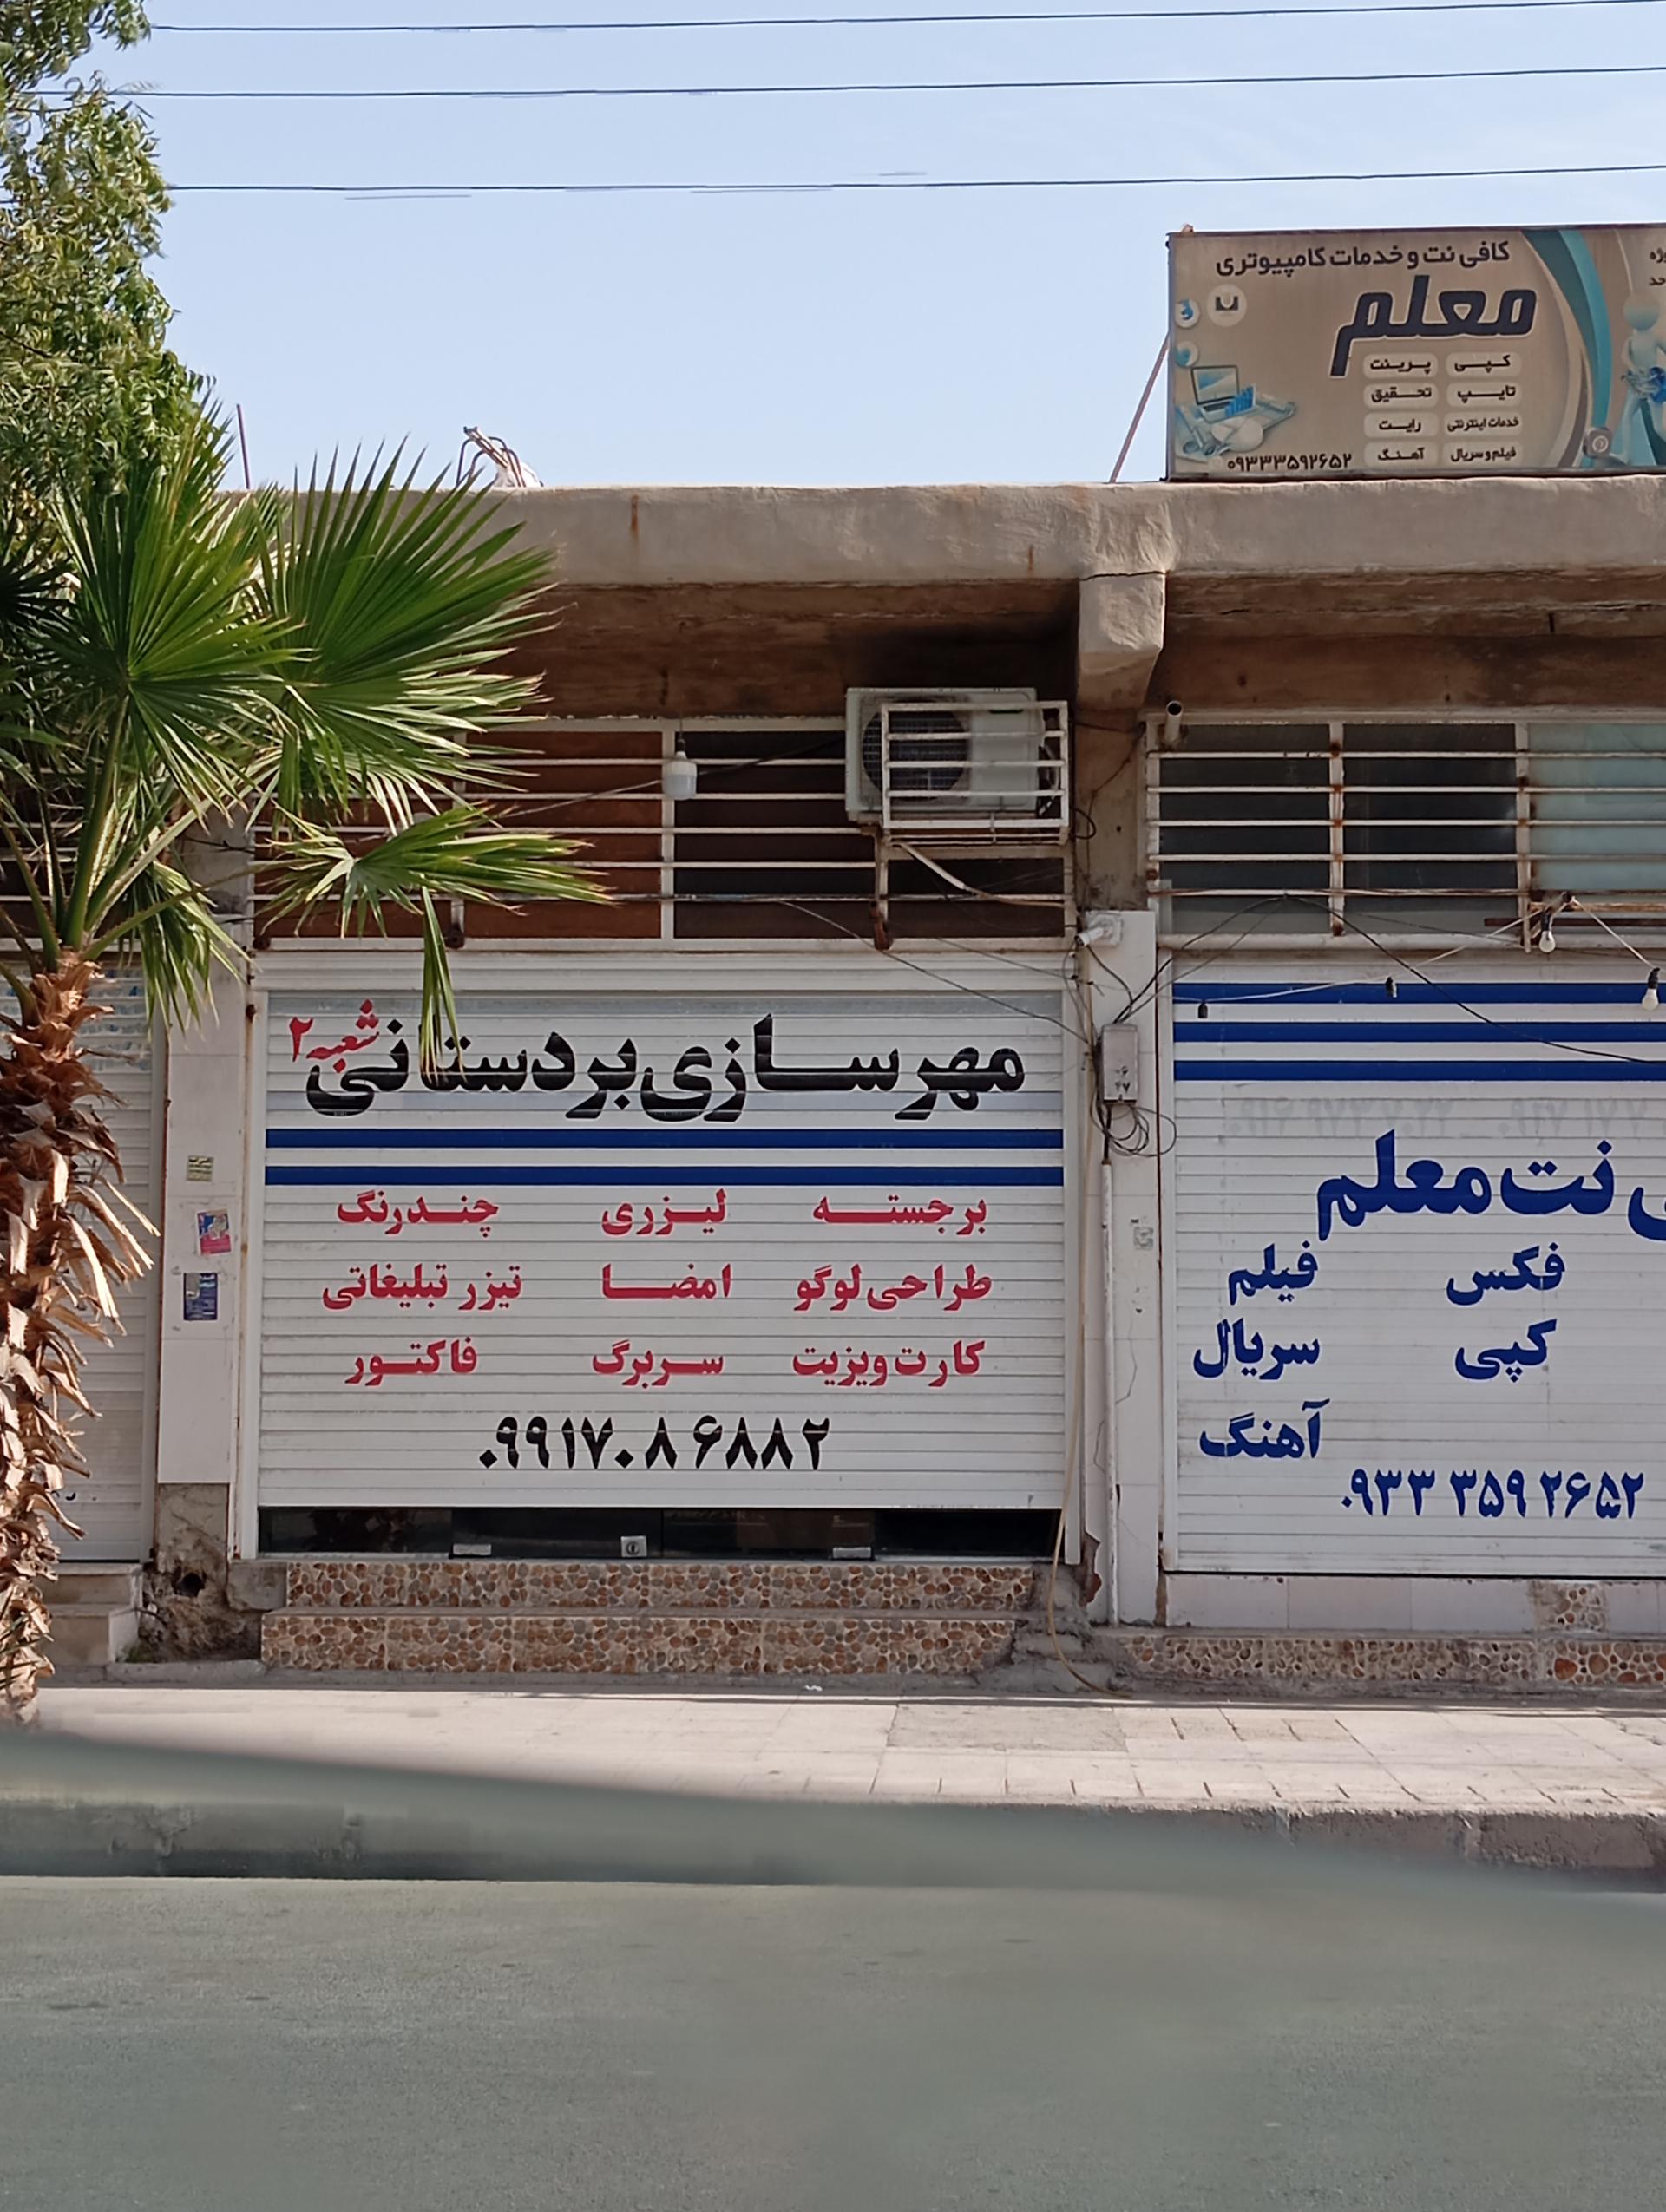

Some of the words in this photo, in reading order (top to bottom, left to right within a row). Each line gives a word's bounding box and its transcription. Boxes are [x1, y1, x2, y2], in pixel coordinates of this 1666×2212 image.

[1216, 246, 1326, 278] کامپیوتری
[1330, 245, 1403, 265] خدمات
[1407, 250, 1419, 270] و
[1423, 246, 1455, 263] نت
[1459, 241, 1510, 268] کافی
[1330, 274, 1538, 377] معلم
[1369, 357, 1432, 375] پرینت
[1453, 354, 1512, 374] کپی
[1370, 386, 1433, 402] تحقیق
[1456, 384, 1517, 404] تایپ
[1378, 418, 1422, 433] رایت
[1446, 418, 1486, 433] اینترنتی
[1487, 416, 1519, 428] خدمات
[1227, 453, 1352, 472] ۰۹۳۳۳۵۹۲۶۵۲
[1377, 447, 1425, 461] آهنگ
[1450, 448, 1484, 462] سریال
[1492, 446, 1517, 461] فیلم
[289, 1017, 314, 1063] ۲
[306, 998, 380, 1074] شعبه
[1315, 1128, 1493, 1242] معلم
[1499, 1139, 1616, 1216] نت
[601, 1188, 727, 1236] لیزری
[321, 1262, 449, 1311] تبلیغاتی
[458, 1264, 523, 1312] تیزر
[600, 1263, 732, 1300] امضا
[793, 1263, 863, 1312] لوگو
[866, 1263, 993, 1312] طراحی
[1228, 1240, 1319, 1306] فیلم
[1446, 1241, 1566, 1306] فکس
[344, 1336, 479, 1388] فاکتور
[791, 1345, 888, 1388] ویزیت
[894, 1339, 987, 1388] کارت
[1192, 1317, 1321, 1381] سریال
[1454, 1318, 1558, 1383] کپی
[1198, 1397, 1330, 1459] آهنگ
